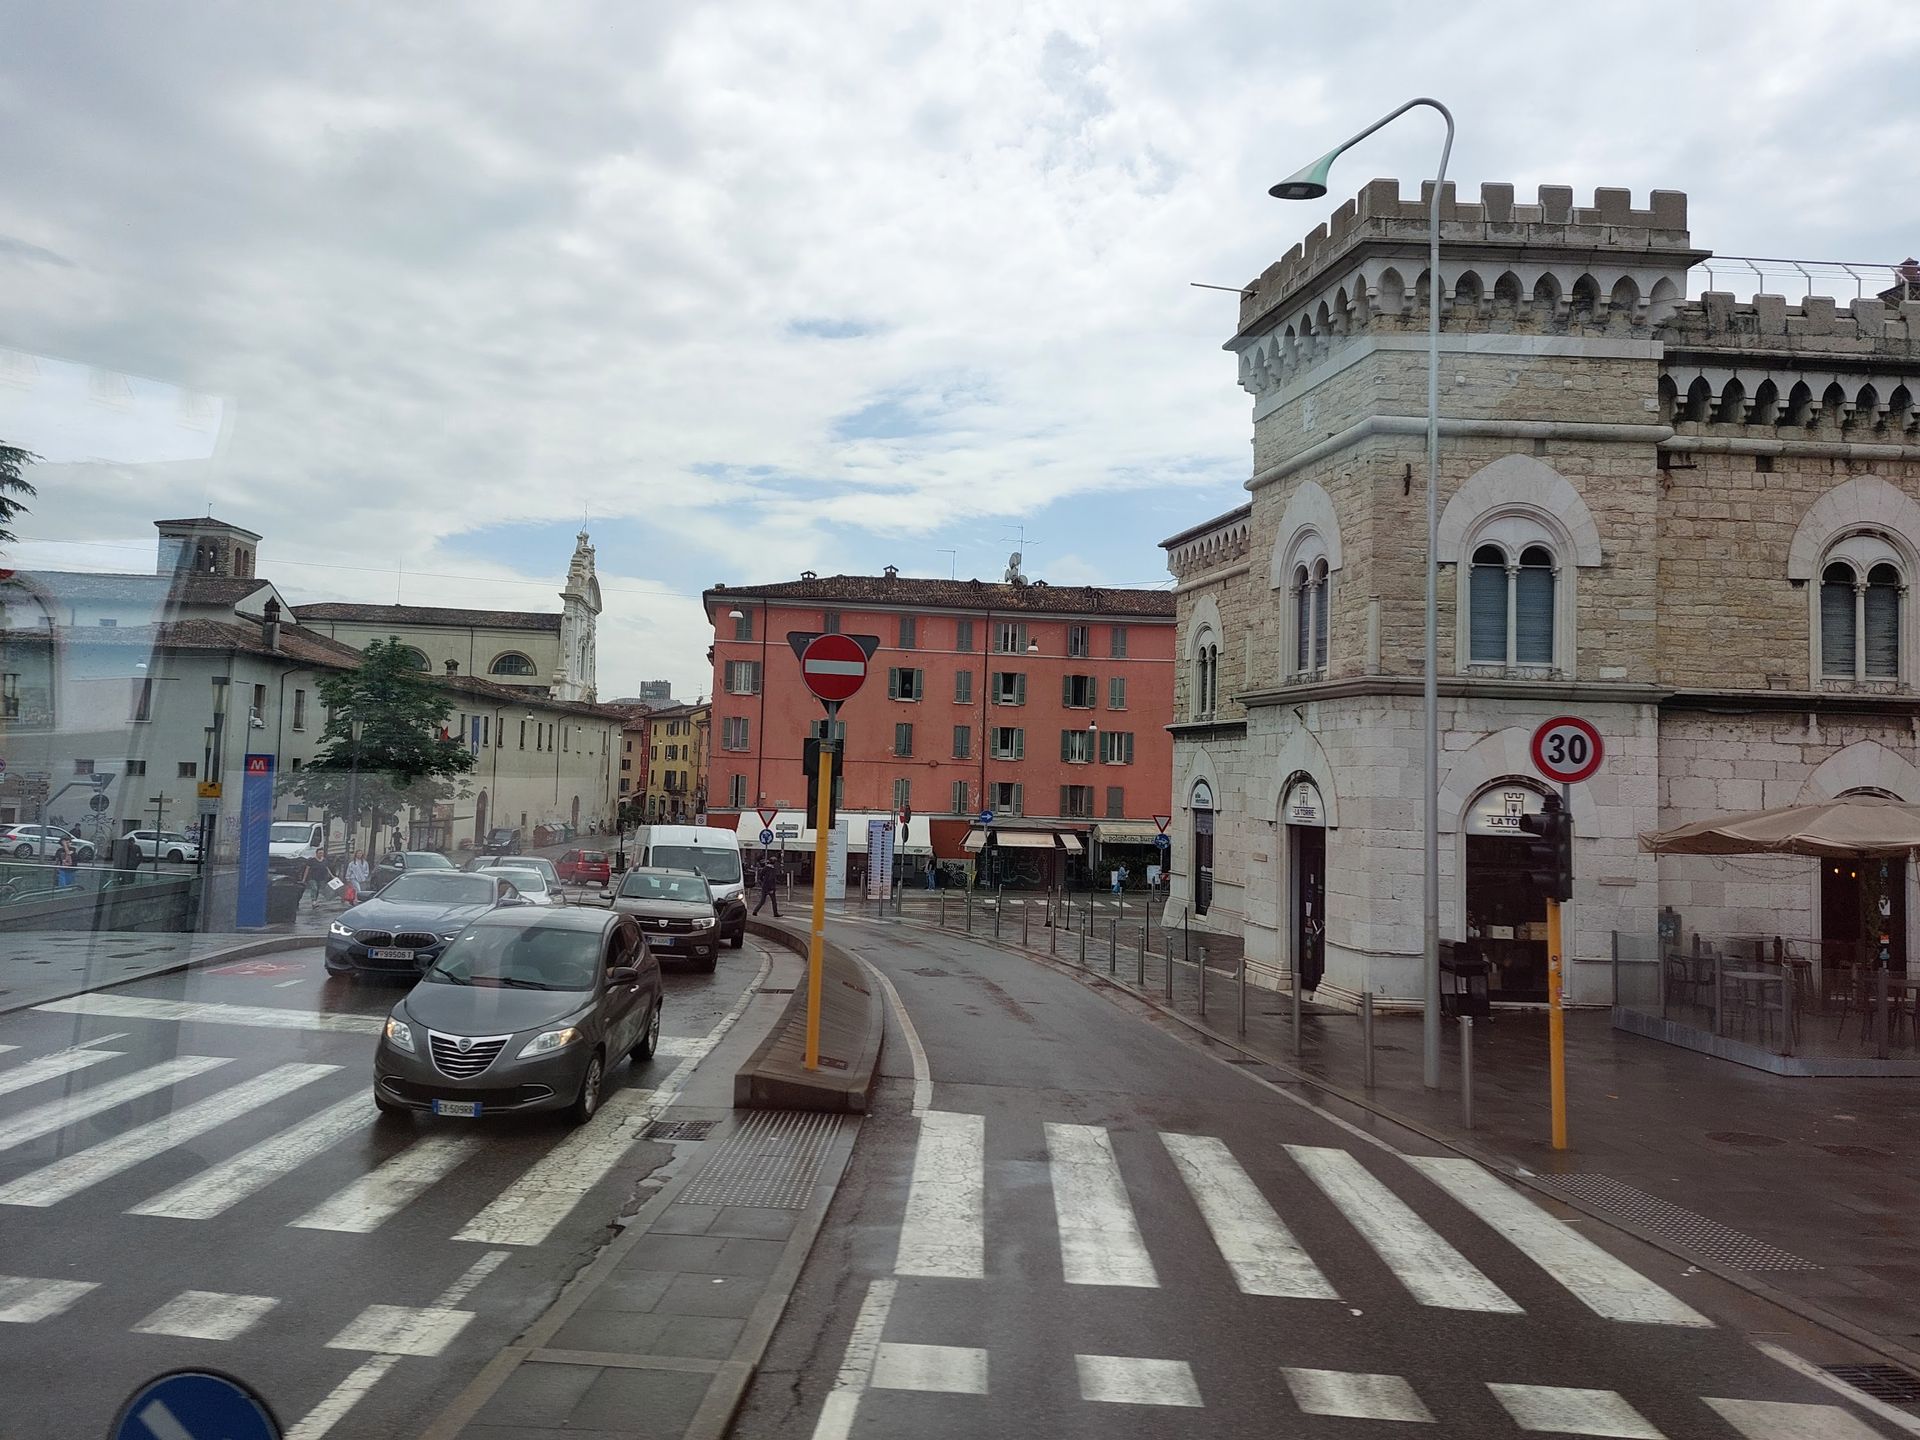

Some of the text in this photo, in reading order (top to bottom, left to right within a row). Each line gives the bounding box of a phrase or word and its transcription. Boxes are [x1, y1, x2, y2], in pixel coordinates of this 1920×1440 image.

[1548, 734, 1587, 764] 30
[250, 759, 265, 770] M
[1491, 817, 1504, 825] LA
